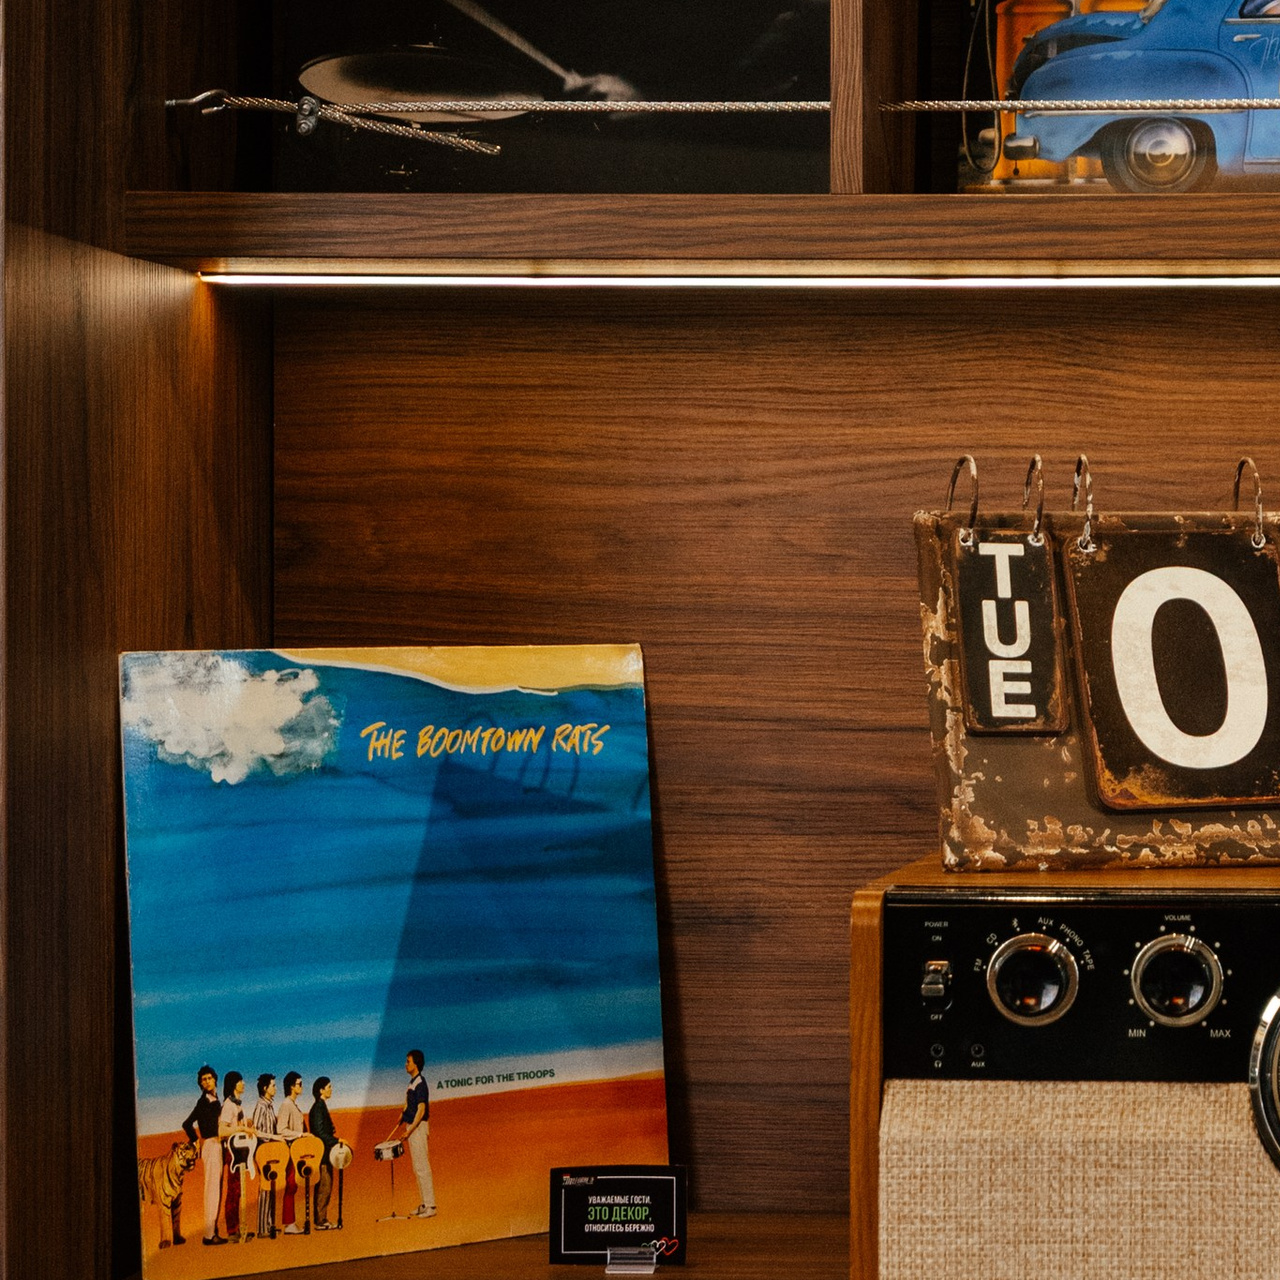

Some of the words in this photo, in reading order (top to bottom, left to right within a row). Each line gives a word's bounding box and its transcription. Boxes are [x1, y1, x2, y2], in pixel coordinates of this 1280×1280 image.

[979, 543, 1037, 718] TUE
[360, 722, 406, 760] THE
[417, 725, 545, 757] BOOMTOWN
[552, 724, 610, 755] RATS
[924, 920, 949, 928] POWER
[1038, 917, 1054, 926] AUX
[986, 933, 998, 944] CD
[1060, 923, 1084, 947] PHONO
[974, 958, 982, 971] FM
[1083, 949, 1095, 970] TAPE
[1129, 1029, 1146, 1038] MIN
[1211, 1029, 1231, 1038] MAX
[437, 1081, 444, 1089] A
[445, 1077, 472, 1088] TONIC
[475, 1075, 494, 1085] FOR
[496, 1073, 515, 1082] THE
[516, 1069, 555, 1080] TROOPS
[588, 1195, 629, 1204] УВАЖАЕМЫЕ
[587, 1206, 609, 1220] ЭТО
[611, 1206, 652, 1222] ДЕКОР,
[584, 1223, 624, 1232] ОТНОСИТЕСЬ
[625, 1224, 655, 1232] БЕРЕЖНО
